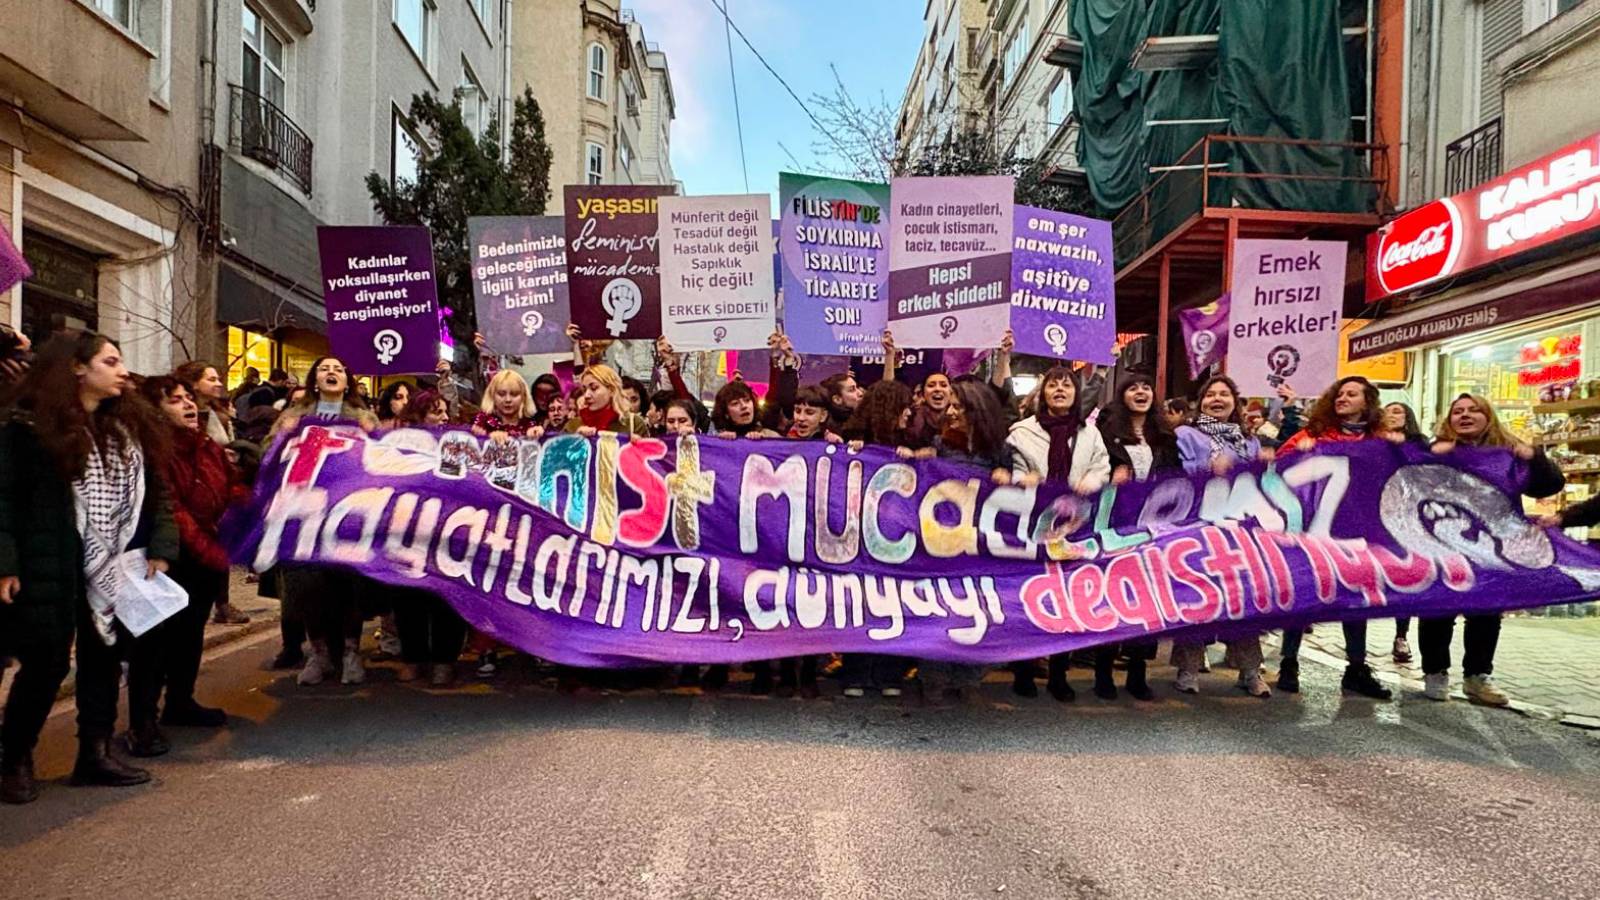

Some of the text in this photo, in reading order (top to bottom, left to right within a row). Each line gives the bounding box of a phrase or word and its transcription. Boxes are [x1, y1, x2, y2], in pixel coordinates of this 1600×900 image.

[1480, 146, 1600, 221] KALEL
[671, 209, 759, 225] Münferit değil
[793, 194, 881, 224] FİLİSTİN'DE
[900, 202, 1003, 220] Kadın cinayetleri,
[673, 224, 758, 240] Tesadüf değil
[795, 225, 883, 250] SOYKIRIMA
[904, 221, 999, 238] çocuk istismarı,
[1028, 217, 1088, 240] em şer
[478, 235, 565, 259] Bedenimizle
[673, 241, 725, 256] Hastalık
[728, 240, 759, 257] değil
[905, 238, 997, 254] taciz, tecavüz...
[1015, 235, 1104, 265] naxwazin,
[347, 254, 408, 270] Kadınlar
[691, 257, 742, 272] Sapıklık
[804, 249, 877, 275] İSRAİL'LE
[1257, 250, 1322, 275] Emek
[327, 270, 431, 291] yoksullaşırken
[681, 272, 753, 292] hiç değil!
[928, 261, 972, 286] Hepsi
[1022, 267, 1091, 293] aşitîye
[354, 288, 408, 304] diyanet
[481, 276, 514, 297] ilgili
[804, 276, 879, 301] TİCARETE
[1253, 285, 1322, 307] hırsızı
[504, 290, 554, 310] bizim!
[897, 281, 1003, 315] erkek şiddeti!
[1010, 289, 1106, 321] dixwazin!
[333, 300, 432, 321] zenginleşiyor!
[668, 301, 769, 318] ERKEK ŞİDDETİ!
[824, 305, 862, 326] SON!
[1233, 310, 1338, 339] erkekler!
[1352, 305, 1499, 354] KALELİOĞLU KURUYEMİŞ
